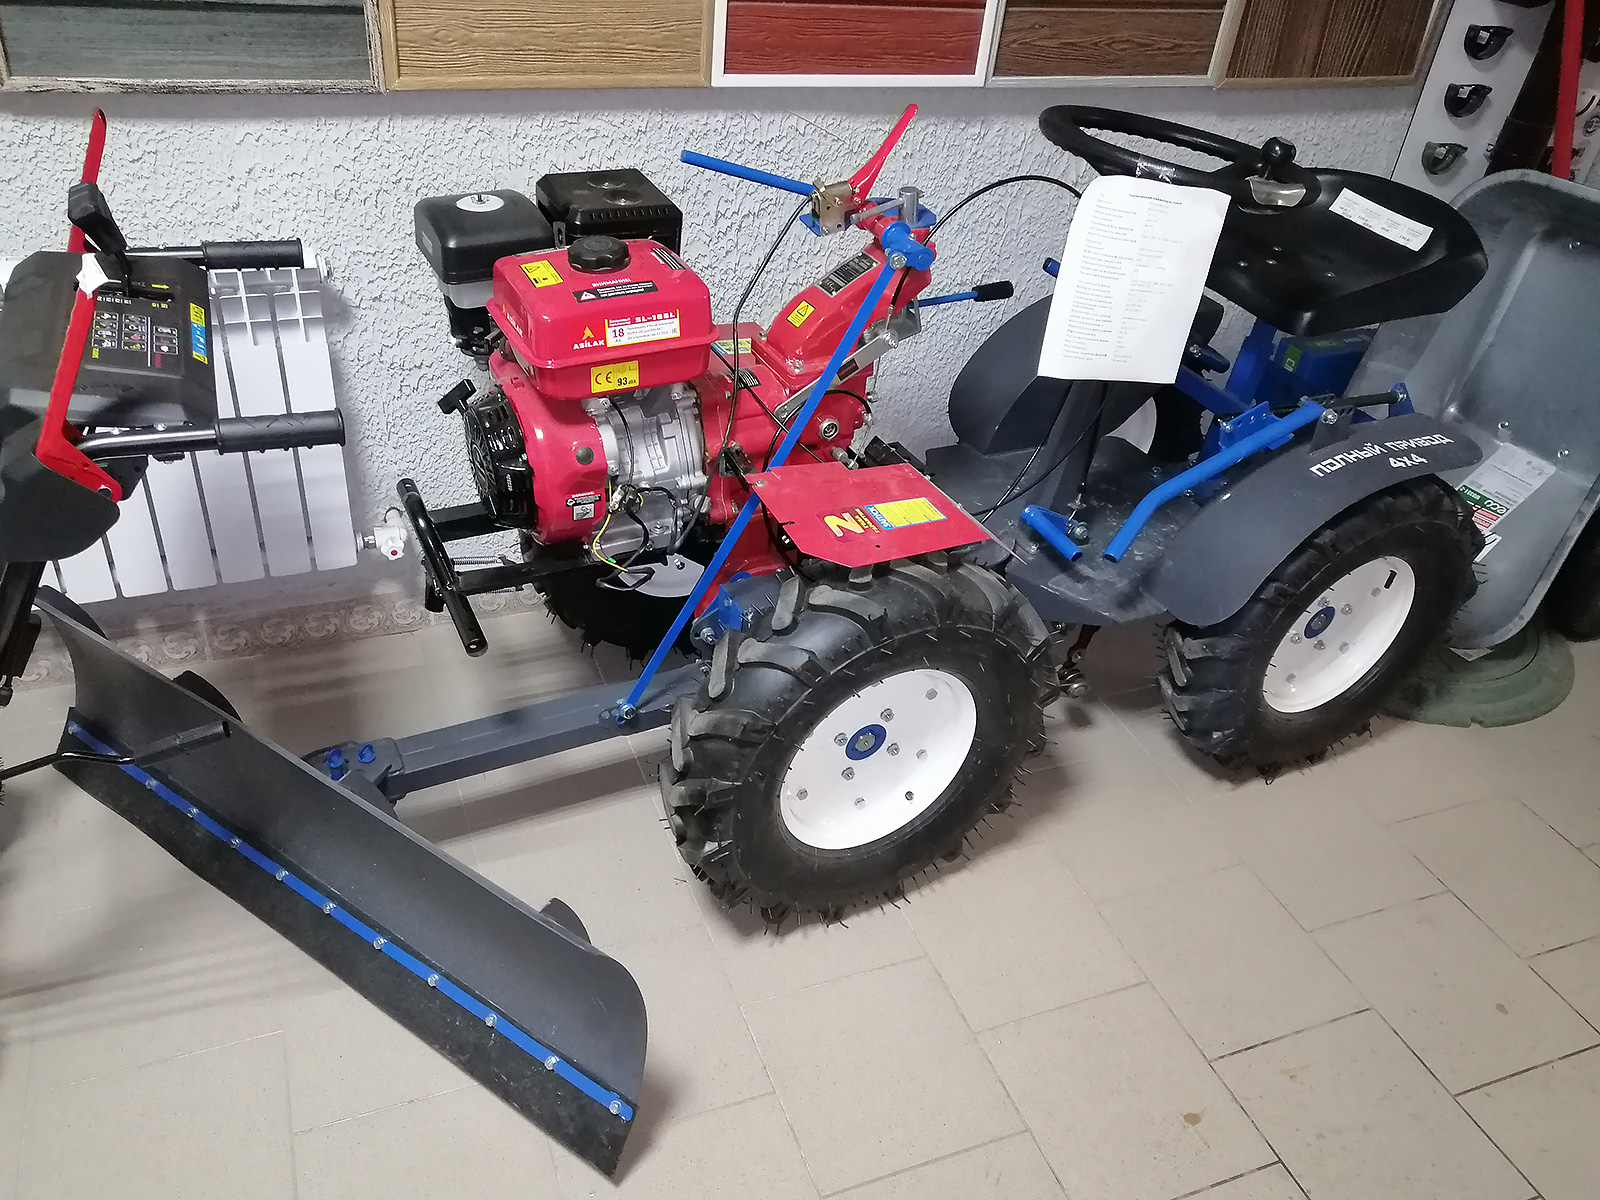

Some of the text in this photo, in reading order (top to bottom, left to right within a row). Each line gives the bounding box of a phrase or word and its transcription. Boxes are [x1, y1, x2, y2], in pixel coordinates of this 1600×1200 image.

[612, 328, 625, 339] 18
[617, 376, 628, 387] 93
[1309, 433, 1454, 478] ПОЛНЫЙ ПРИВОД
